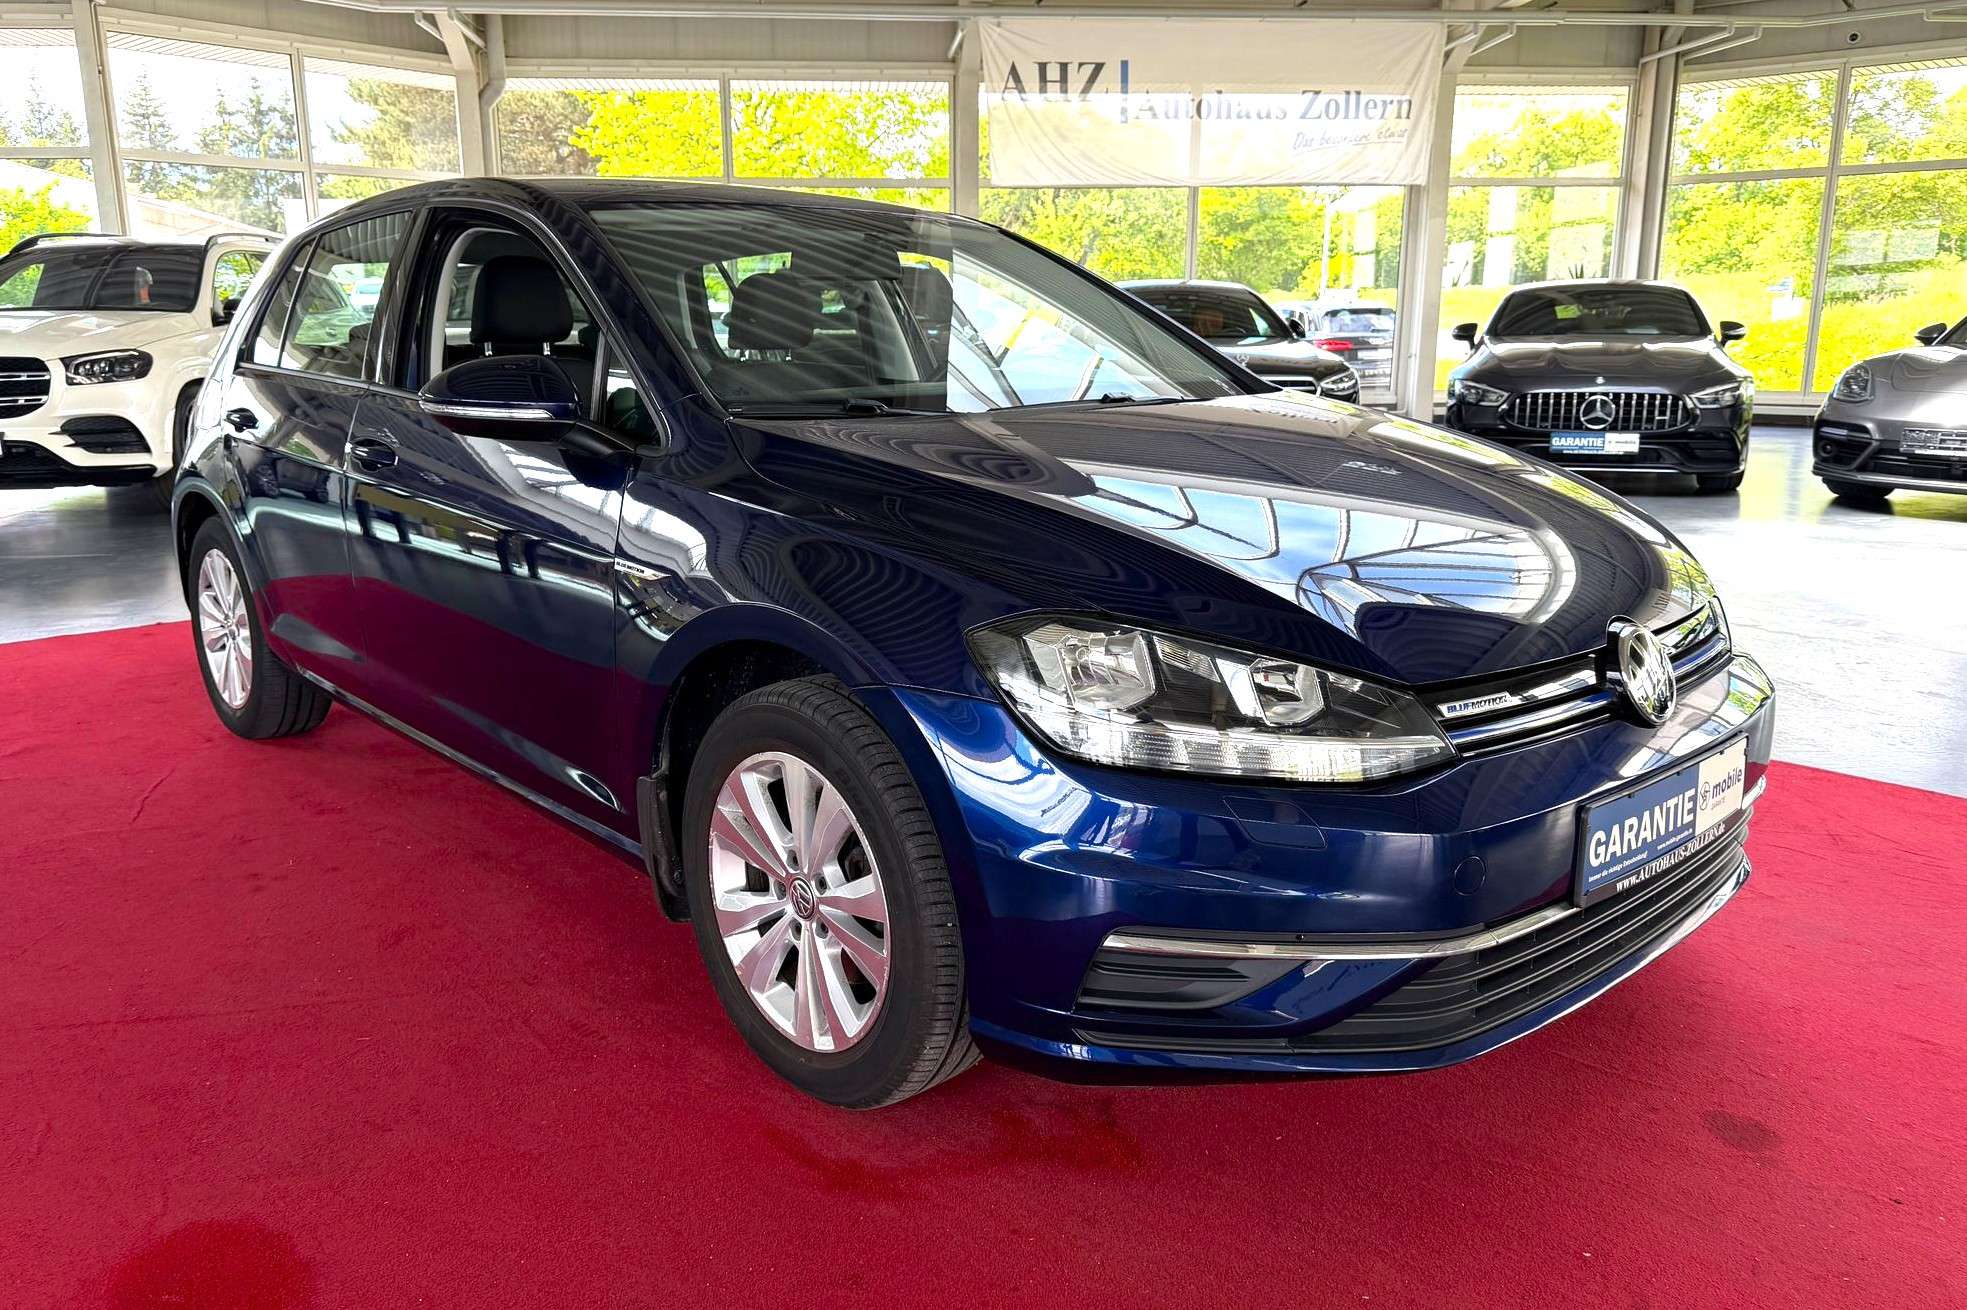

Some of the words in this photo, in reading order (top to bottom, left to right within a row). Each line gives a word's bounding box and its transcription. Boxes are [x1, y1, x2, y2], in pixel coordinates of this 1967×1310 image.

[1000, 60, 1107, 103] AHZ
[1133, 90, 1288, 121] Autohaus
[1298, 89, 1413, 121] Zollern
[1552, 437, 1605, 447] GARANTIE
[1446, 694, 1508, 714] BLUEMOTION
[1711, 766, 1743, 800] mobile
[1588, 787, 1696, 868] GARANTIE
